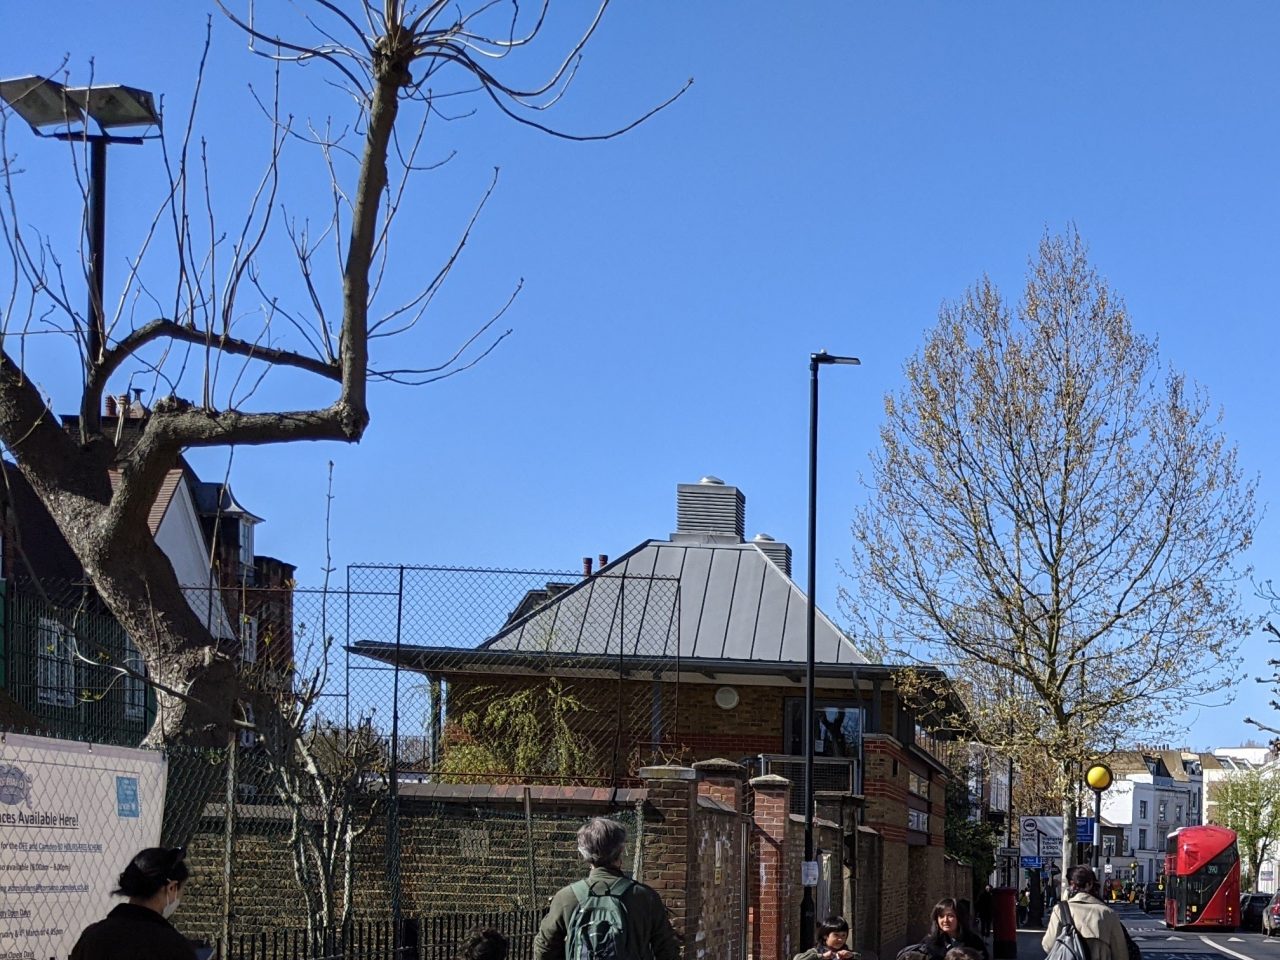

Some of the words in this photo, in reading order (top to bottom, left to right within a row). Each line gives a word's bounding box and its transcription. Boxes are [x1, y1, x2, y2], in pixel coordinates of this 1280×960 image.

[18, 811, 57, 826] Available
[59, 813, 79, 827] Here!
[1208, 865, 1218, 874] 390
